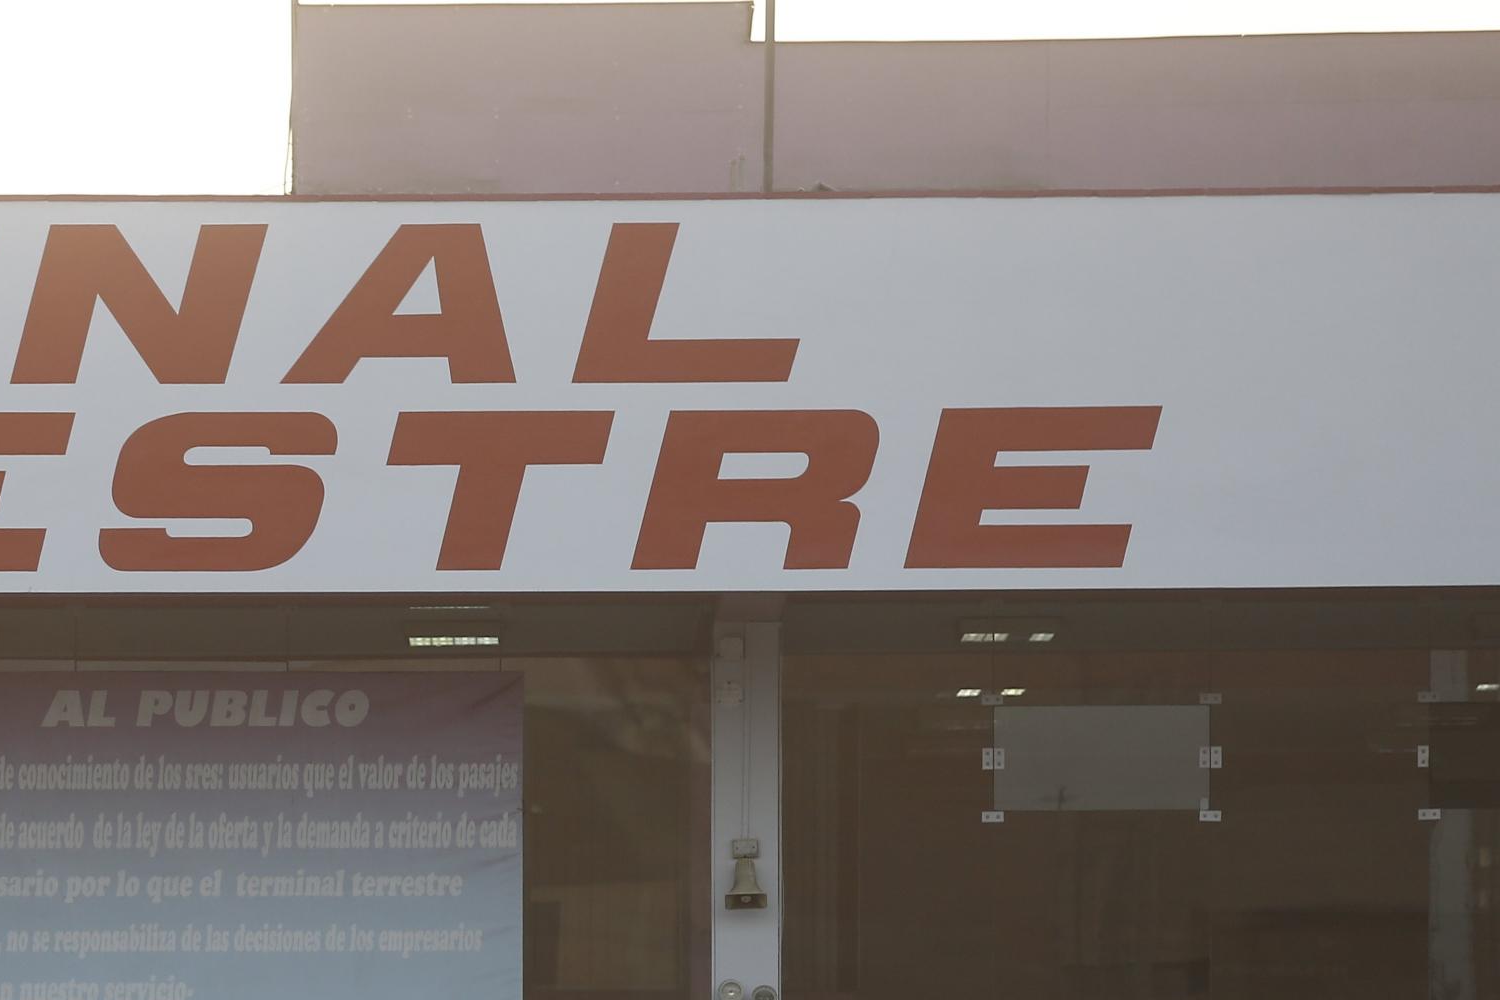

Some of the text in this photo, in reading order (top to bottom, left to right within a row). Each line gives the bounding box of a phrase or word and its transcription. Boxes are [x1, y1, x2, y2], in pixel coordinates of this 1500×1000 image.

[40, 689, 370, 727] AL PUBLICO
[18, 756, 130, 790] conocimiento
[134, 756, 154, 790] de
[157, 756, 181, 790] los
[228, 755, 300, 790] usuarios
[303, 763, 335, 798] que
[338, 755, 356, 790] el
[359, 755, 403, 790] valor
[406, 755, 426, 790] de
[429, 755, 454, 790] los
[458, 755, 518, 798] pasajes
[19, 813, 84, 848] acuerdo
[92, 813, 112, 848] de
[116, 813, 132, 848] la
[136, 813, 161, 857] ley
[165, 813, 185, 848] de
[189, 813, 205, 848] la
[208, 812, 258, 848] oferta
[262, 822, 274, 857] y
[277, 813, 293, 848] la
[296, 813, 371, 848] demanda
[374, 822, 384, 848] a
[388, 812, 452, 848] criterio
[455, 813, 476, 848] de
[479, 813, 517, 848] cada
[64, 875, 111, 903] por
[116, 870, 140, 897] lo
[145, 875, 192, 903] que
[200, 869, 223, 897] el
[236, 869, 345, 897] terminal
[352, 871, 463, 897] terrestre
[6, 930, 29, 952] no
[32, 930, 50, 952] se
[53, 924, 176, 958] responsabiliza
[180, 924, 201, 952] de
[204, 924, 229, 952] las
[234, 924, 321, 952] decisiones
[325, 924, 345, 952] de
[349, 924, 375, 952] los
[379, 924, 483, 958] empresarios
